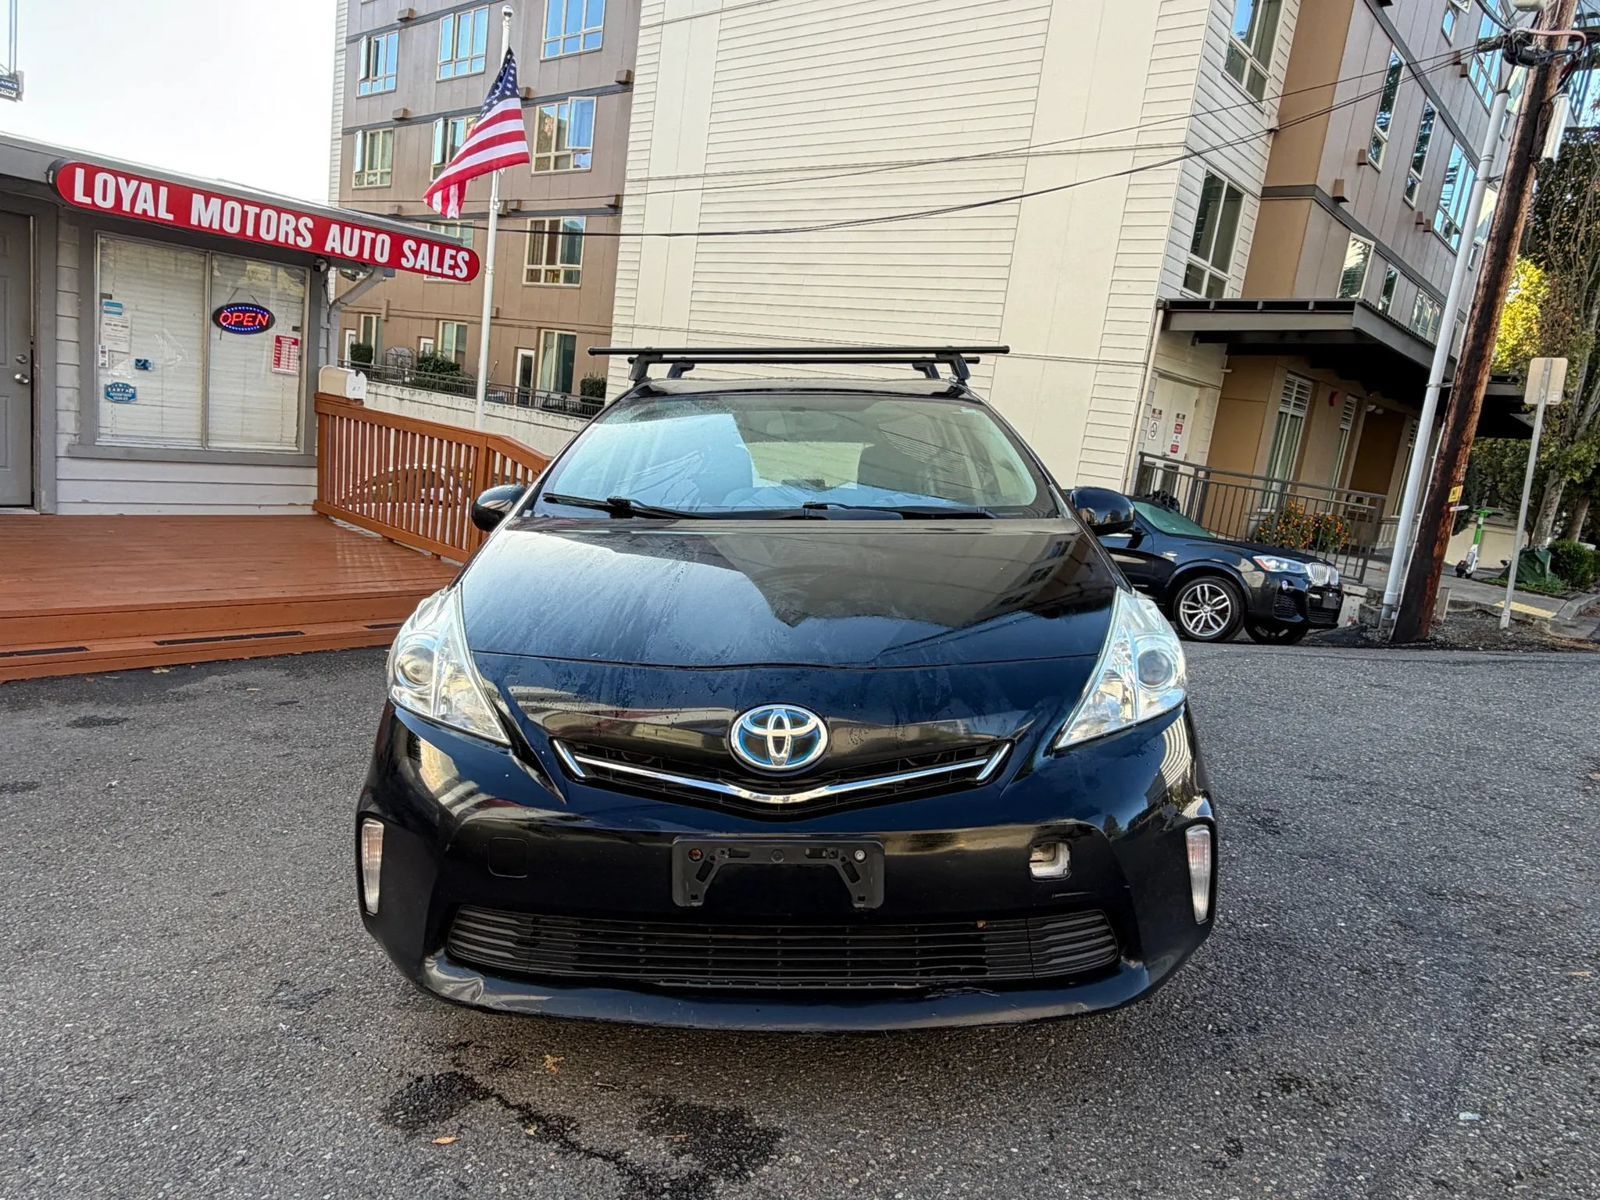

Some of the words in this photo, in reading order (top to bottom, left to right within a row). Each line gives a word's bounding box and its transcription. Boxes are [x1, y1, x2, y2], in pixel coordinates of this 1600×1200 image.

[74, 167, 174, 221] LOYAL
[190, 193, 313, 248] MOTORS
[324, 224, 391, 263] AUTO
[401, 239, 470, 279] SALES
[219, 312, 269, 326] OPEN
